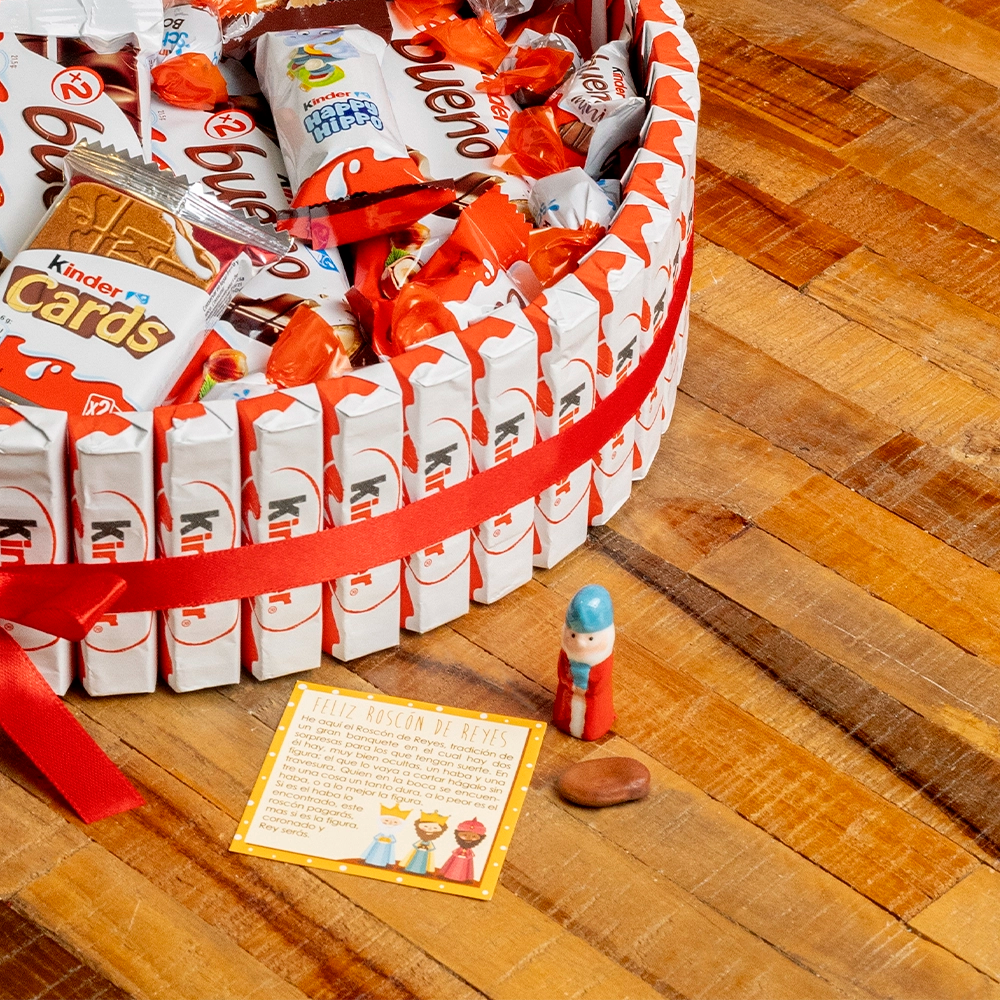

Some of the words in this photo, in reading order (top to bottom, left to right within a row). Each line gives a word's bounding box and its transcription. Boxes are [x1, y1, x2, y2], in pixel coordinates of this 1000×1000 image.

[303, 91, 351, 112] Kinder
[304, 98, 379, 133] Happy
[312, 110, 384, 144] Hippo
[47, 254, 123, 298] Kinder
[4, 272, 170, 354] Cards
[312, 697, 356, 719] FELIZ
[366, 705, 424, 731] ROSCÓN
[434, 719, 452, 737] DE
[461, 723, 507, 748] REYES
[317, 719, 343, 728] aquí
[355, 724, 395, 738] Roscón
[450, 743, 497, 758] tradición
[294, 731, 343, 746] sorpresas
[344, 741, 372, 752] para
[373, 745, 388, 755] los
[390, 750, 413, 760] que
[415, 754, 455, 768] tengan
[456, 763, 492, 775] suerte.
[315, 727, 341, 737] gran
[345, 731, 399, 748] banquete
[437, 750, 463, 760] cual
[466, 755, 488, 766] hay
[491, 760, 512, 770] dos
[282, 763, 297, 772] tre
[297, 767, 320, 777] una
[320, 772, 347, 783] cosa
[364, 779, 394, 791] tanto
[445, 796, 473, 806] peor
[285, 755, 336, 772] travesura.
[339, 766, 373, 778] Quien
[406, 779, 437, 791] boca
[454, 789, 501, 802] encuen-
[329, 747, 354, 758] muy
[355, 751, 380, 762] bien
[442, 768, 473, 780] haba
[484, 777, 506, 787] una
[335, 757, 358, 767] que
[373, 764, 401, 775] vaya
[412, 772, 446, 783] cortar
[447, 777, 487, 792] hágalo
[489, 786, 503, 795] sin
[265, 806, 288, 816] mas
[268, 797, 305, 810] roscón
[311, 787, 342, 799] haba
[340, 803, 364, 812] este
[345, 786, 377, 797] mejor
[390, 793, 425, 807] figura.
[258, 821, 280, 833] Rey
[280, 827, 310, 839] serás.
[261, 815, 317, 830] coronado
